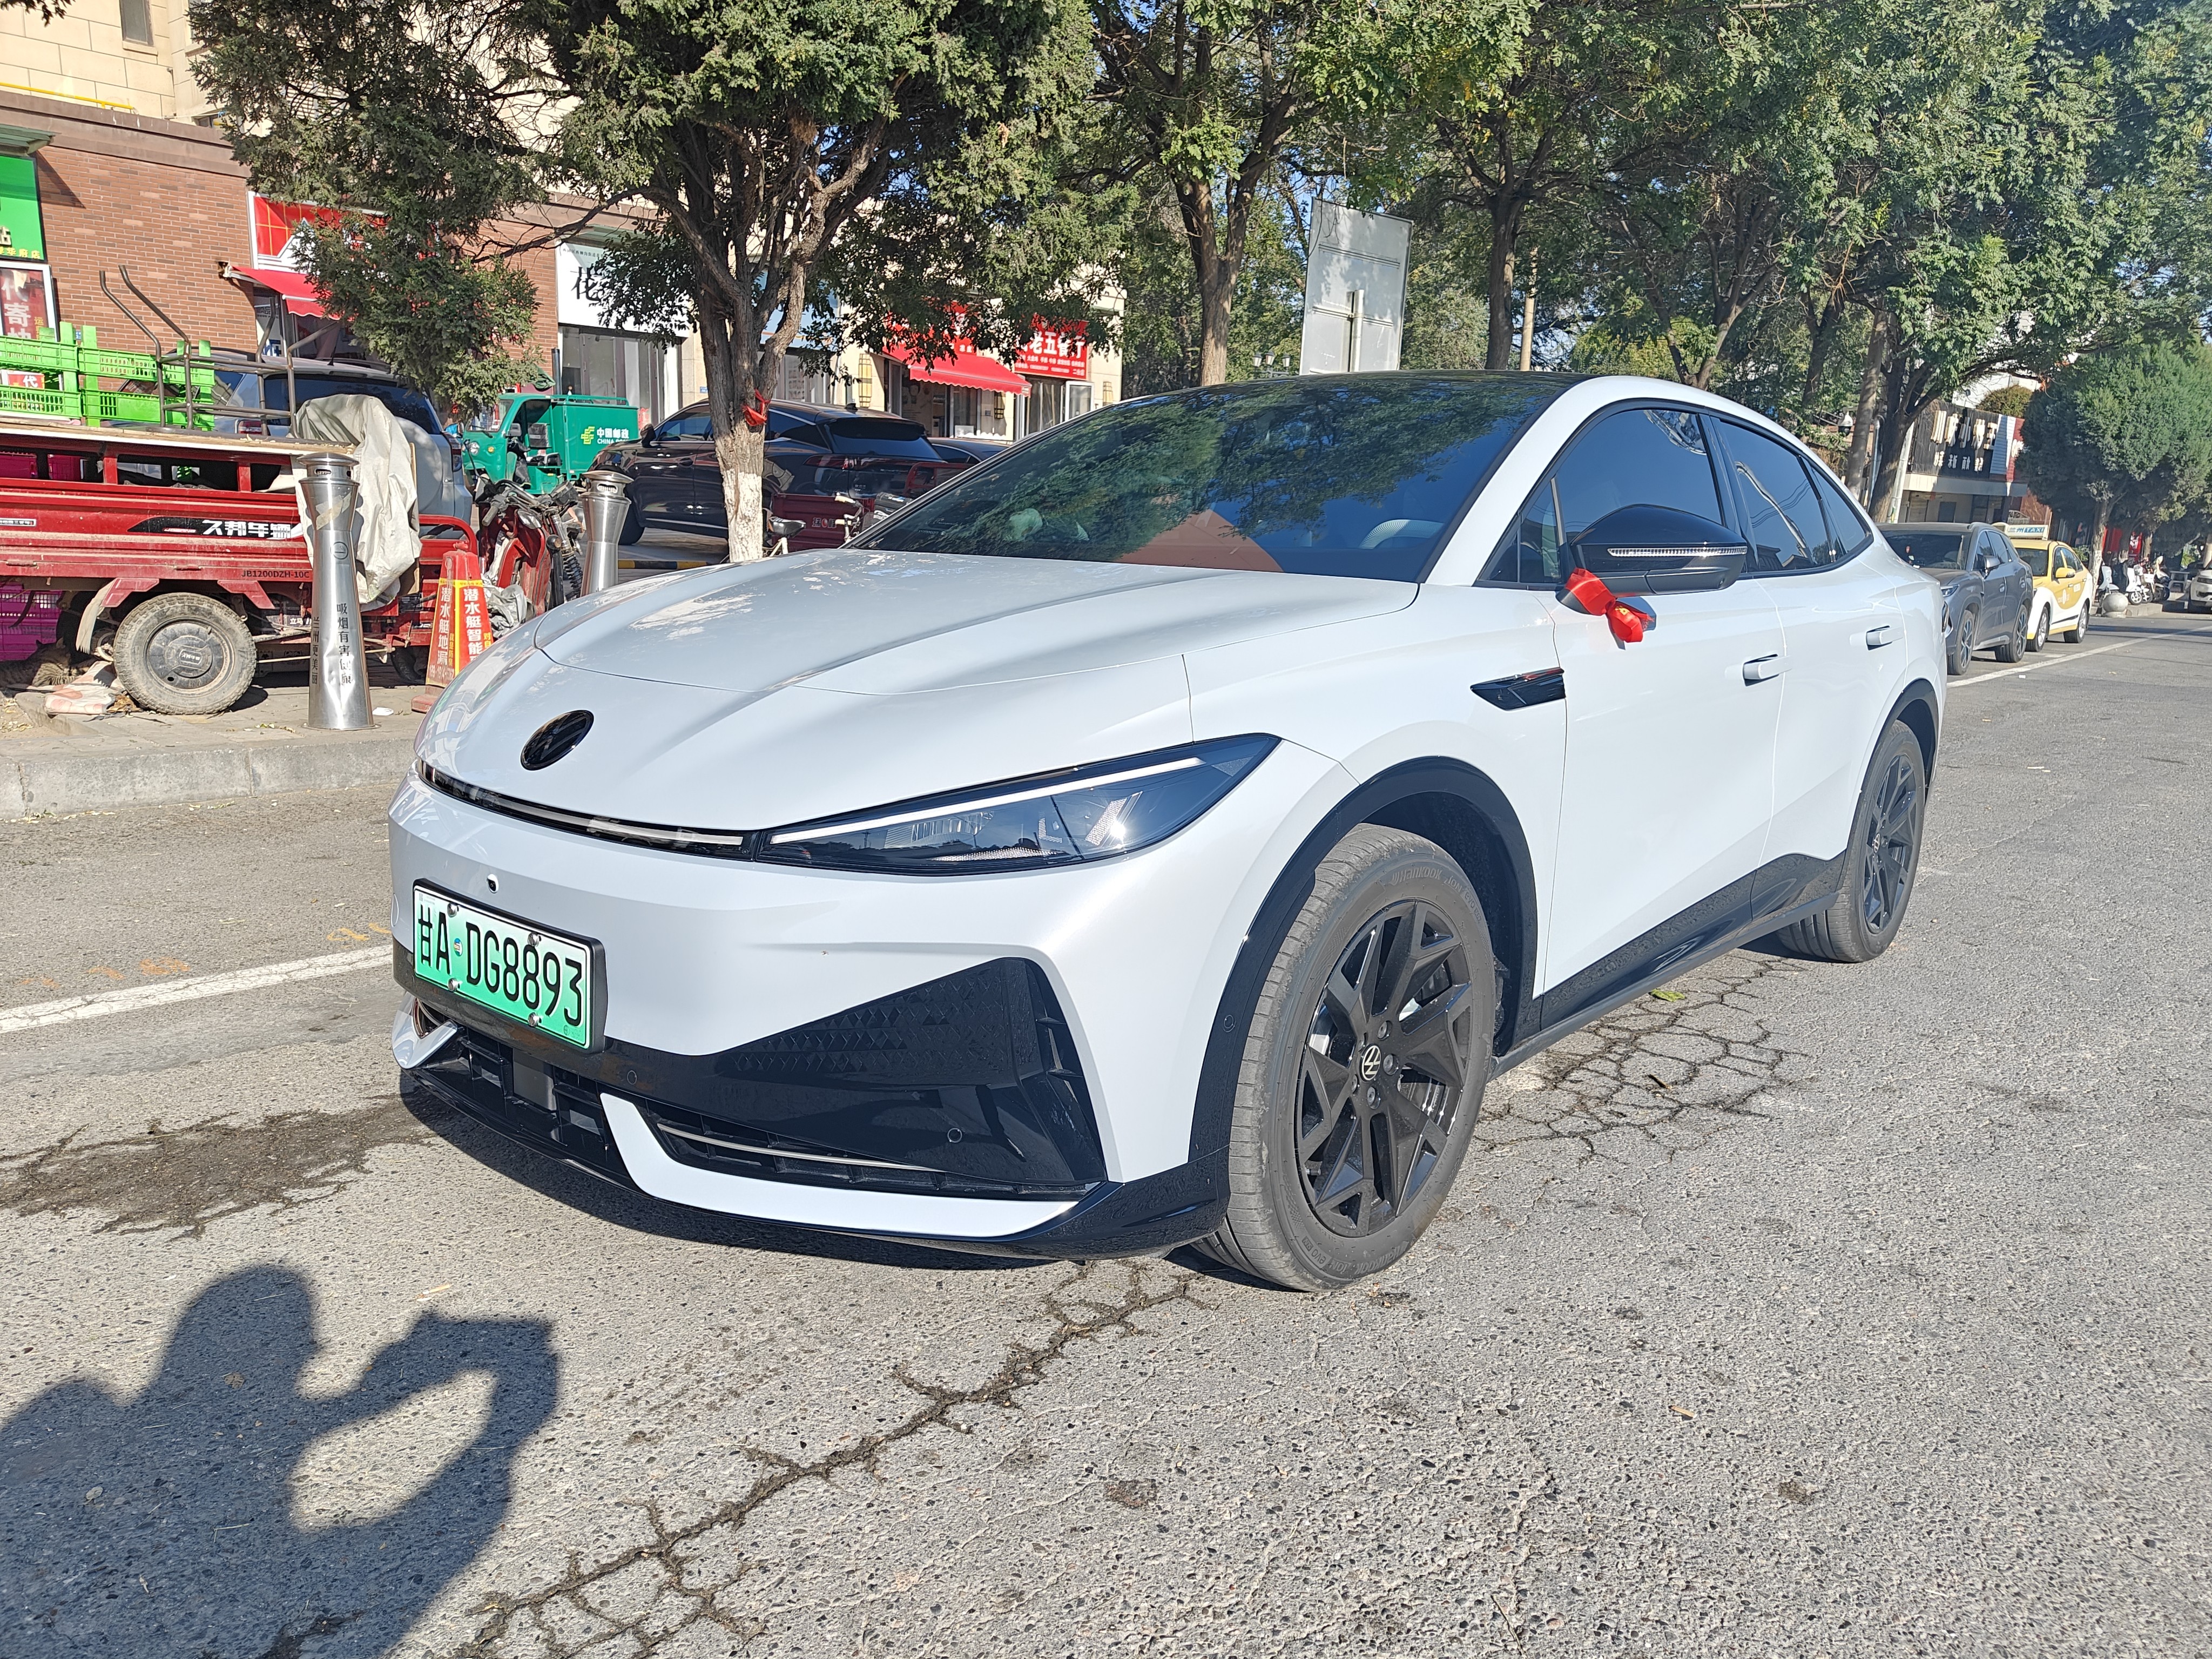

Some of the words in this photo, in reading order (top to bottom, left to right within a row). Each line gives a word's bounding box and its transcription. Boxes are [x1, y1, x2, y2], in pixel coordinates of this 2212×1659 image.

[1015, 331, 1086, 359] 老五餐厅
[597, 427, 629, 439] 中国邮政
[202, 520, 292, 539] 久邦车辆
[241, 570, 309, 578] JB1200DZH-10C
[437, 586, 452, 666] 潜水艇地漏
[311, 616, 320, 685] 兰州更美丽
[1399, 866, 1443, 882] Hankook
[466, 921, 583, 1027] DG8893
